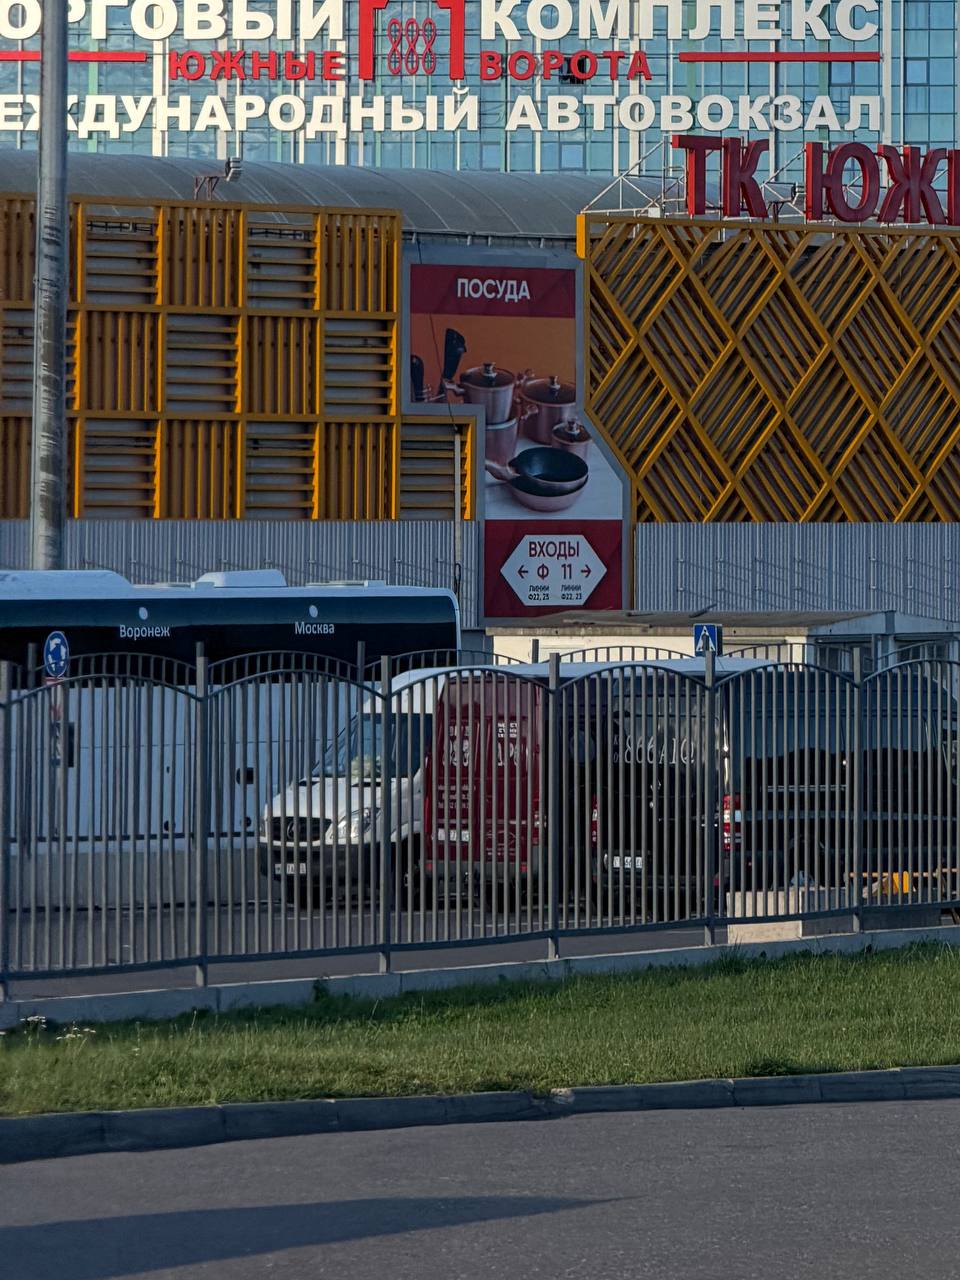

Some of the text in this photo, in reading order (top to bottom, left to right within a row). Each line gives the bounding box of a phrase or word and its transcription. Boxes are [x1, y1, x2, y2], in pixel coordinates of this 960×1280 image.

[168, 50, 653, 81] ЮЖНЫЕ ВОРОТА
[505, 95, 881, 131] АВТОВОКЗАЛ
[671, 134, 769, 218] ТК
[457, 278, 531, 303] ПОСУДА
[528, 541, 580, 560] ВХОДЫ
[537, 563, 573, 580] Ф 11
[119, 624, 170, 641] Воронеж
[295, 621, 335, 635] Москва
